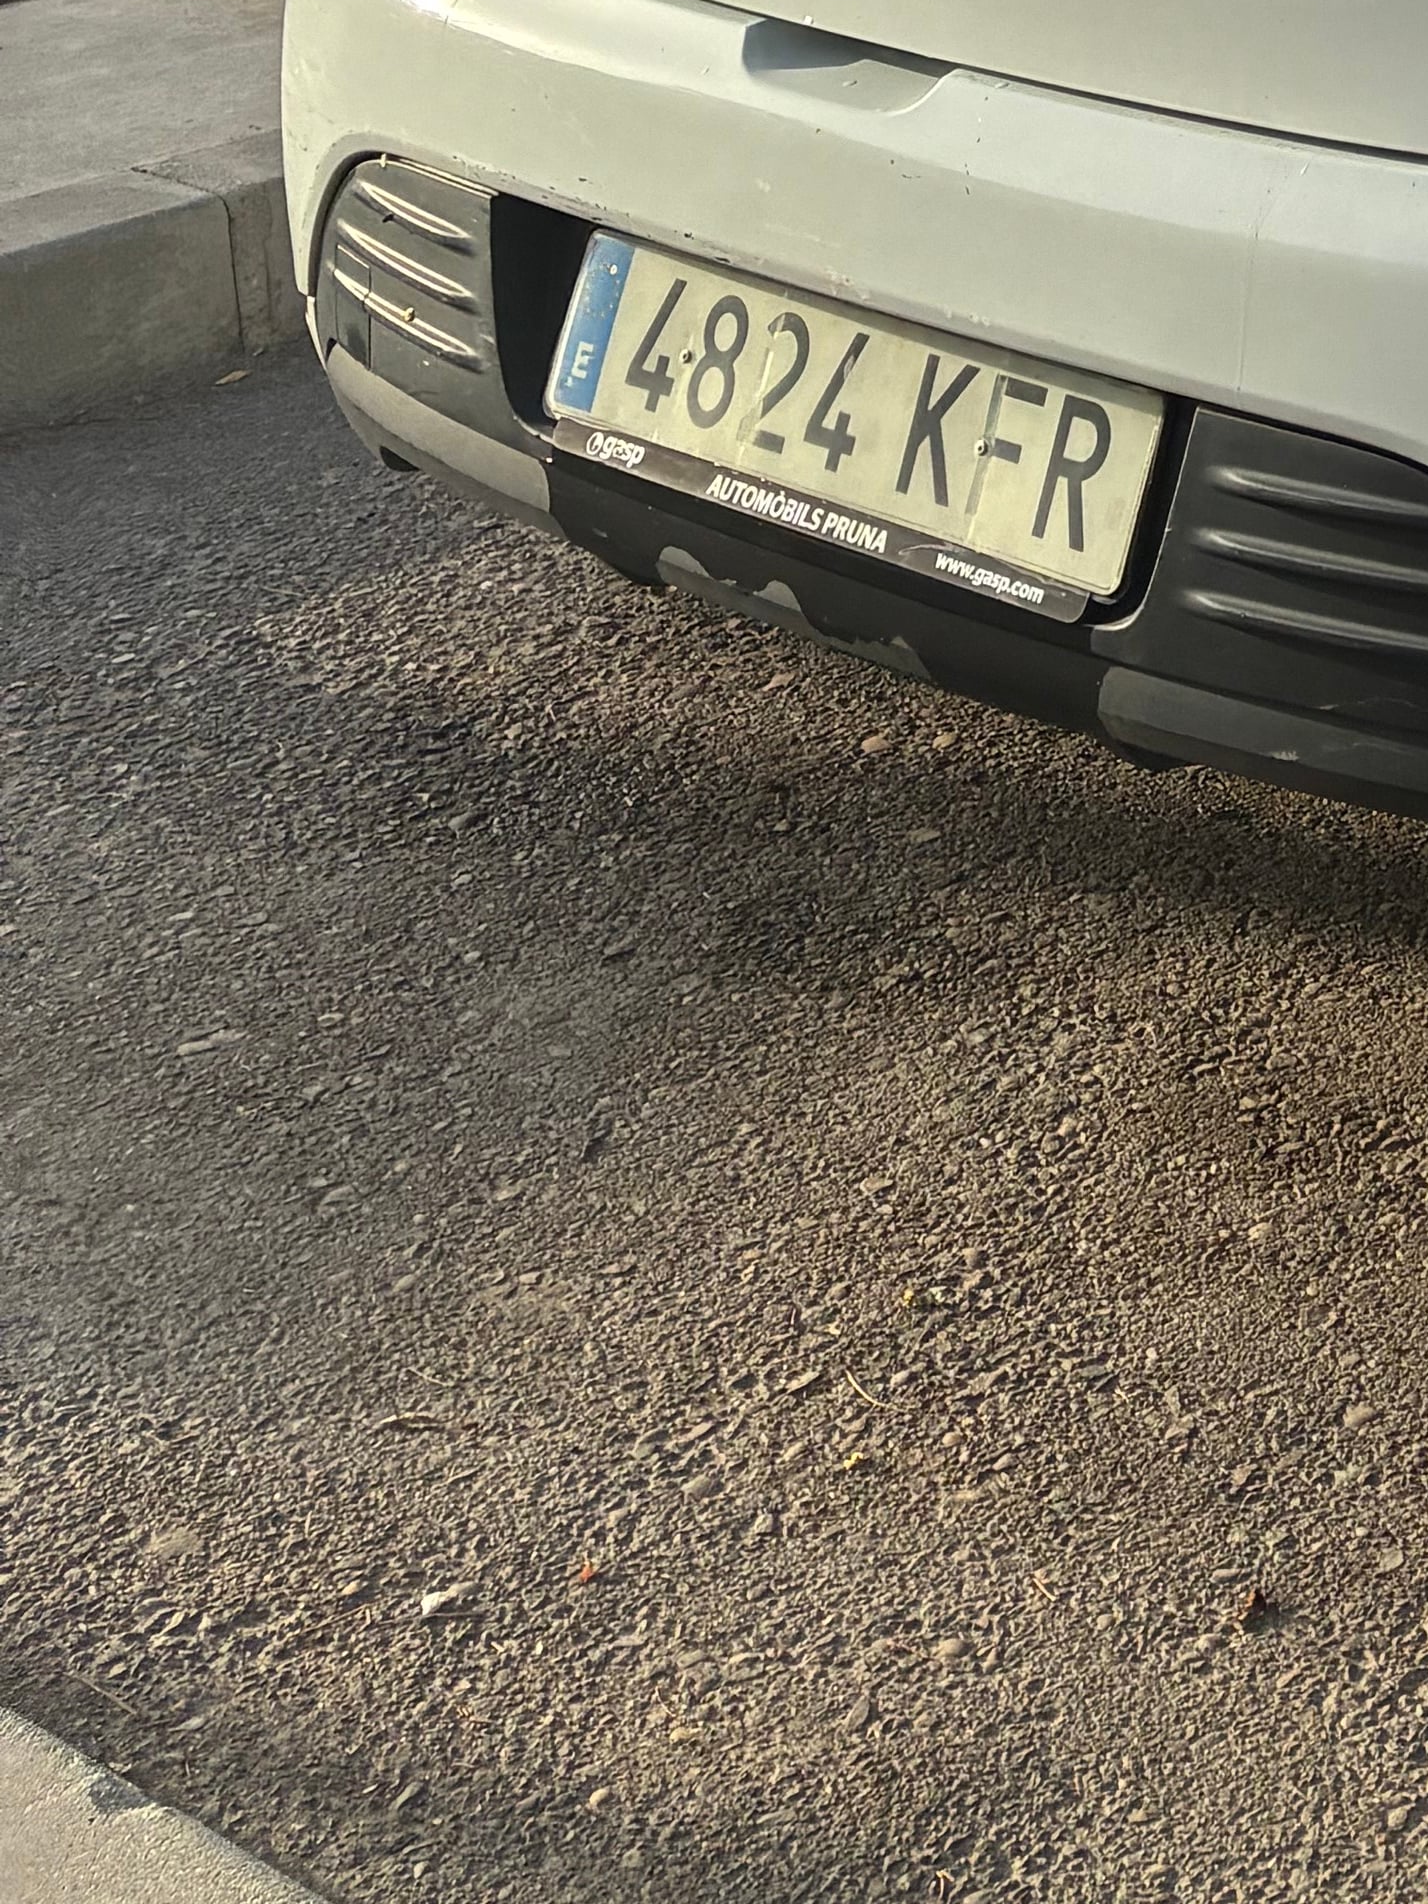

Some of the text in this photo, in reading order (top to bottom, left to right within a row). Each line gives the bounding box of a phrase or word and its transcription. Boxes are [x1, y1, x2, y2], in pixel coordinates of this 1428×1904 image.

[625, 278, 1111, 552] 4824 KFR
[602, 434, 645, 468] gasp
[706, 473, 888, 554] AUTOMÒBILS PRUNA
[935, 552, 1045, 605] www.gasp.com
